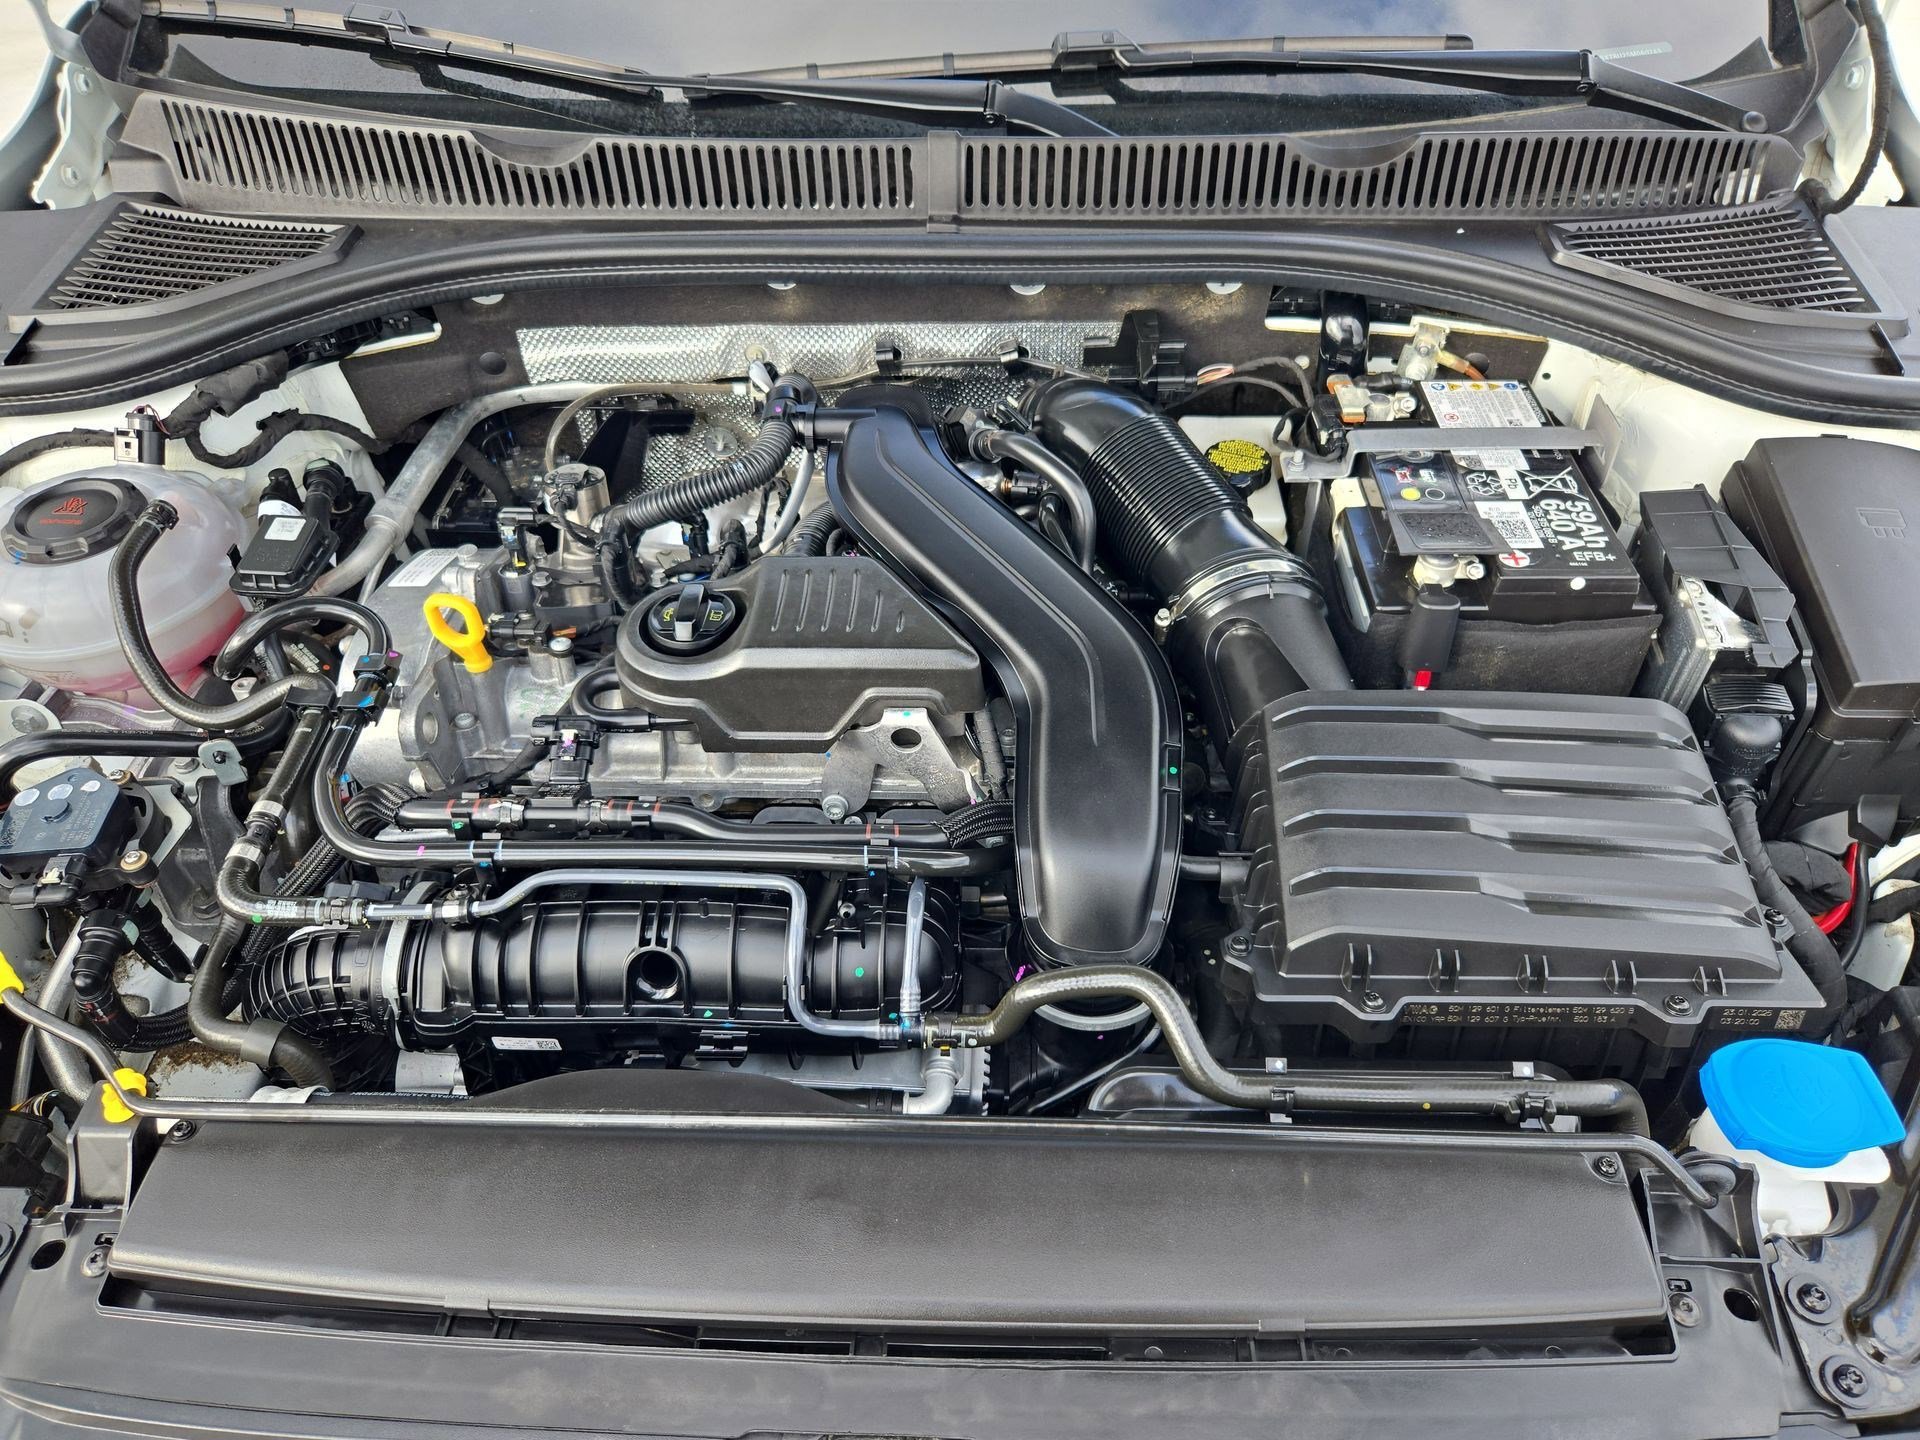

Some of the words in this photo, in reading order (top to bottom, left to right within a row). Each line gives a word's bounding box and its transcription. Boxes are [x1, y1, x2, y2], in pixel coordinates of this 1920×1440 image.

[1505, 478, 1518, 489] Pb
[1540, 499, 1577, 532] 640
[1566, 500, 1609, 548] 59Ah
[1557, 536, 1585, 550] A
[1573, 551, 1617, 561] EFB+
[1722, 1008, 1773, 1017] 23.01.2025
[1719, 1017, 1760, 1025] 03:20:00
